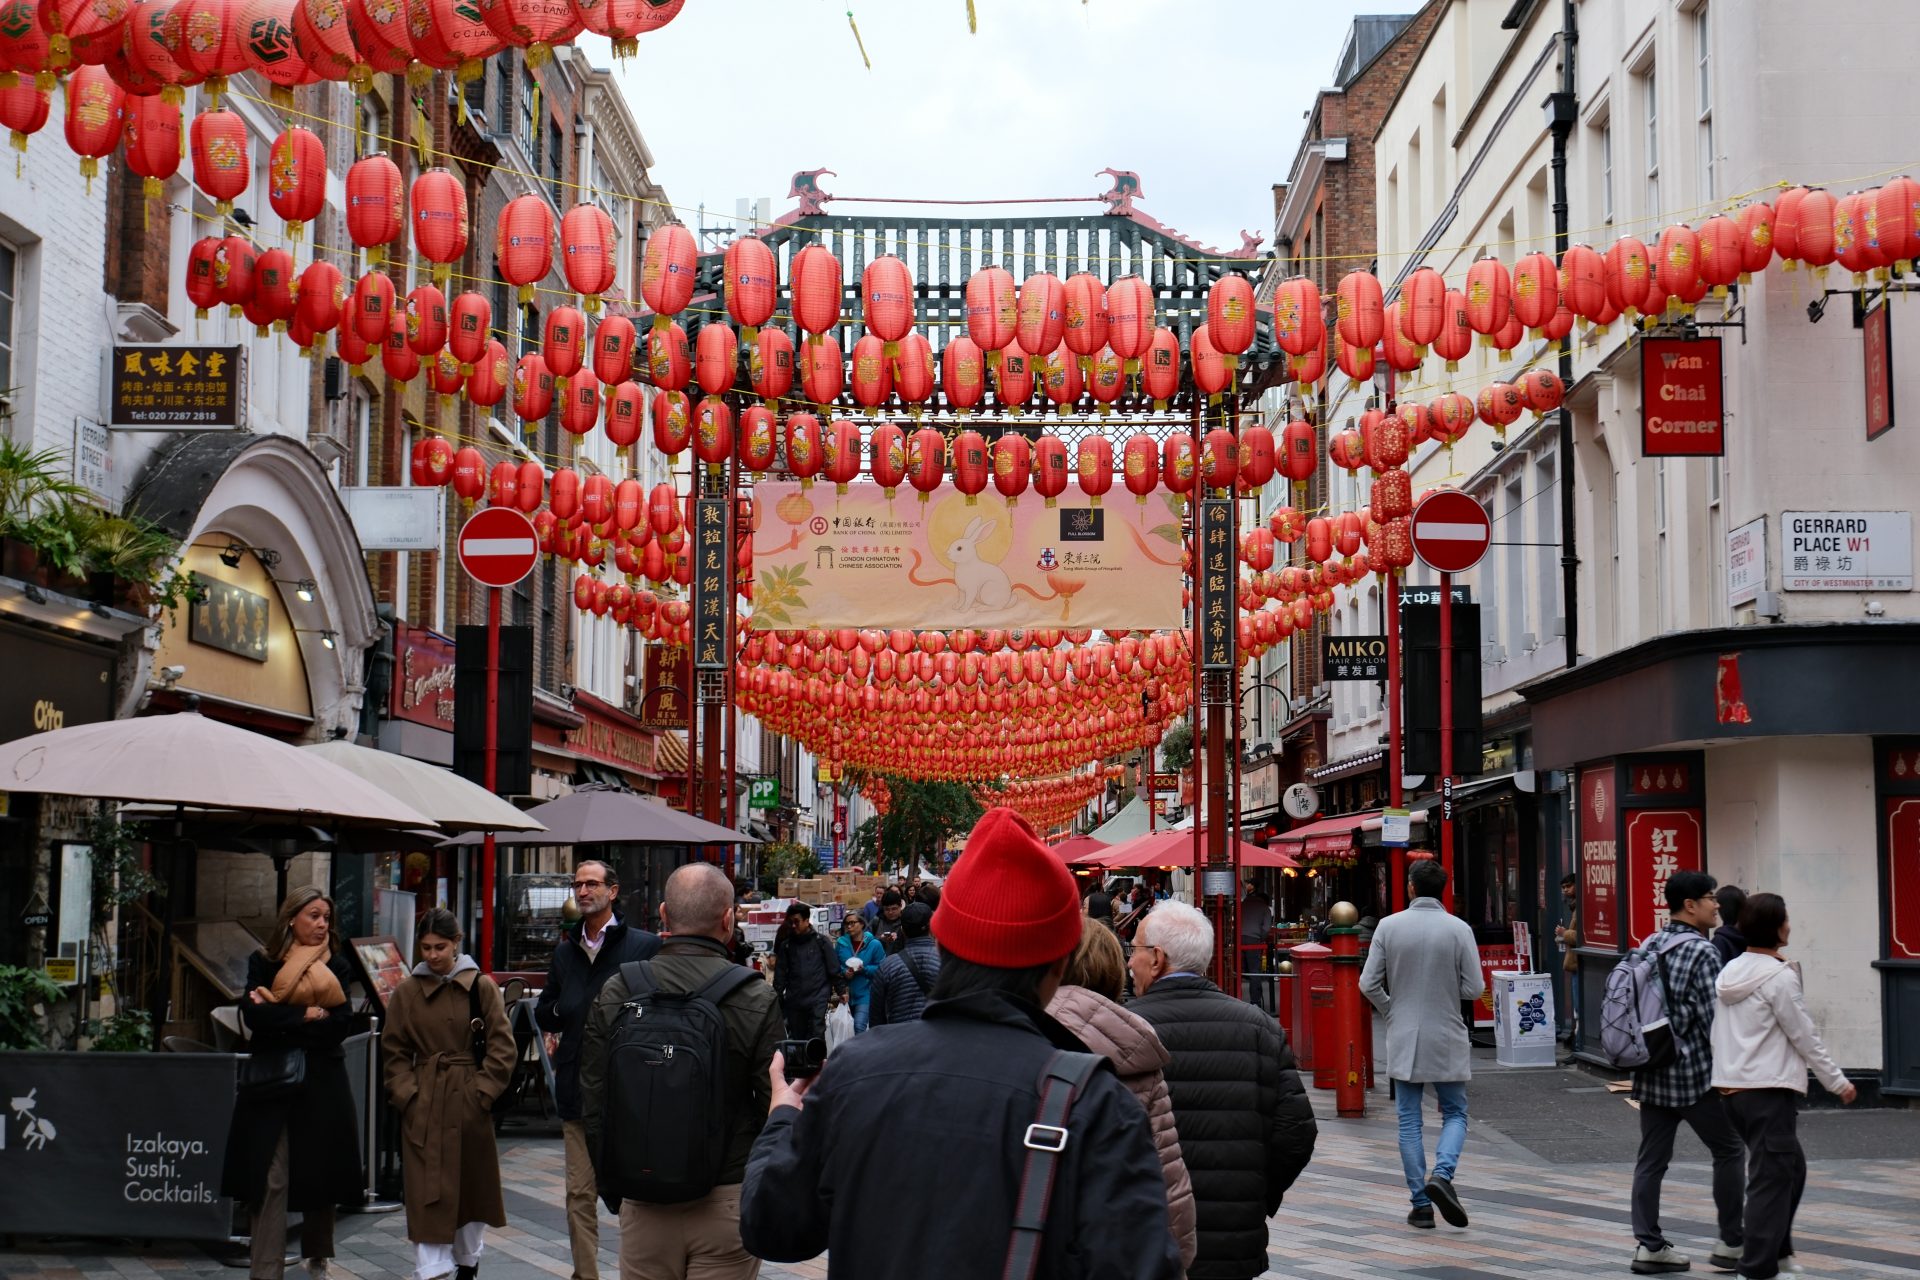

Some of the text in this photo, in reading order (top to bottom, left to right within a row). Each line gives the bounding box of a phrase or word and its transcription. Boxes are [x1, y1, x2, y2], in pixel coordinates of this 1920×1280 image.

[543, 5, 570, 16] LAND
[266, 68, 292, 79] LAND
[1660, 352, 1703, 369] Wan
[1660, 384, 1706, 401] Chai
[131, 411, 217, 420] Tel: 020 7287 2818
[1647, 416, 1718, 434] Corner
[1793, 519, 1867, 533] GERRARD
[1730, 531, 1750, 552] GERRARD
[1793, 538, 1870, 551] PLACE W1
[1730, 551, 1746, 569] STREET
[1794, 579, 1808, 587] CITY
[1811, 579, 1820, 587] OF
[1824, 579, 1873, 587] WESTMINSTER
[1328, 641, 1386, 657] MIKO
[657, 711, 678, 719] NEW
[752, 781, 774, 798] PP
[1584, 840, 1616, 861] OPENING
[1591, 863, 1611, 885] SOON
[24, 916, 48, 925] OPEN
[126, 1132, 209, 1159] Izakaya.
[125, 1156, 181, 1179] Sushi.
[124, 1181, 218, 1204] Cocktails.
